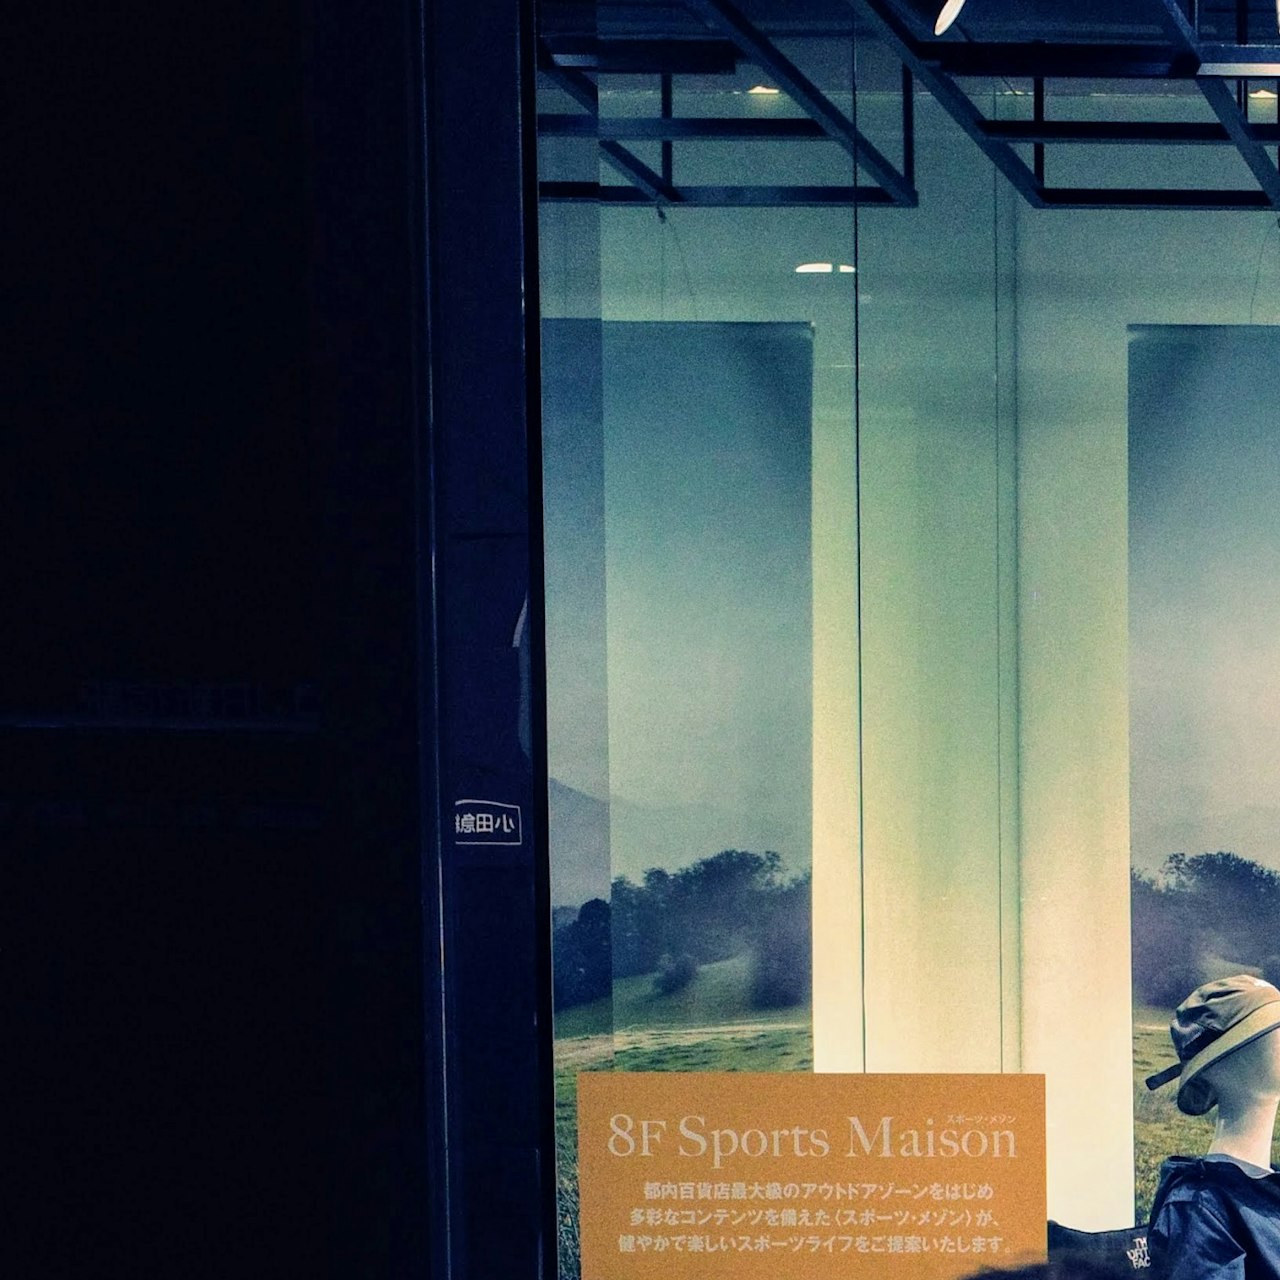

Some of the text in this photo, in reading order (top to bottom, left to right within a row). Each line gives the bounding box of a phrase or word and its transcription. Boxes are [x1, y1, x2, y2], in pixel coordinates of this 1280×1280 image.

[607, 1113, 1018, 1170] 8F Sports Maison
